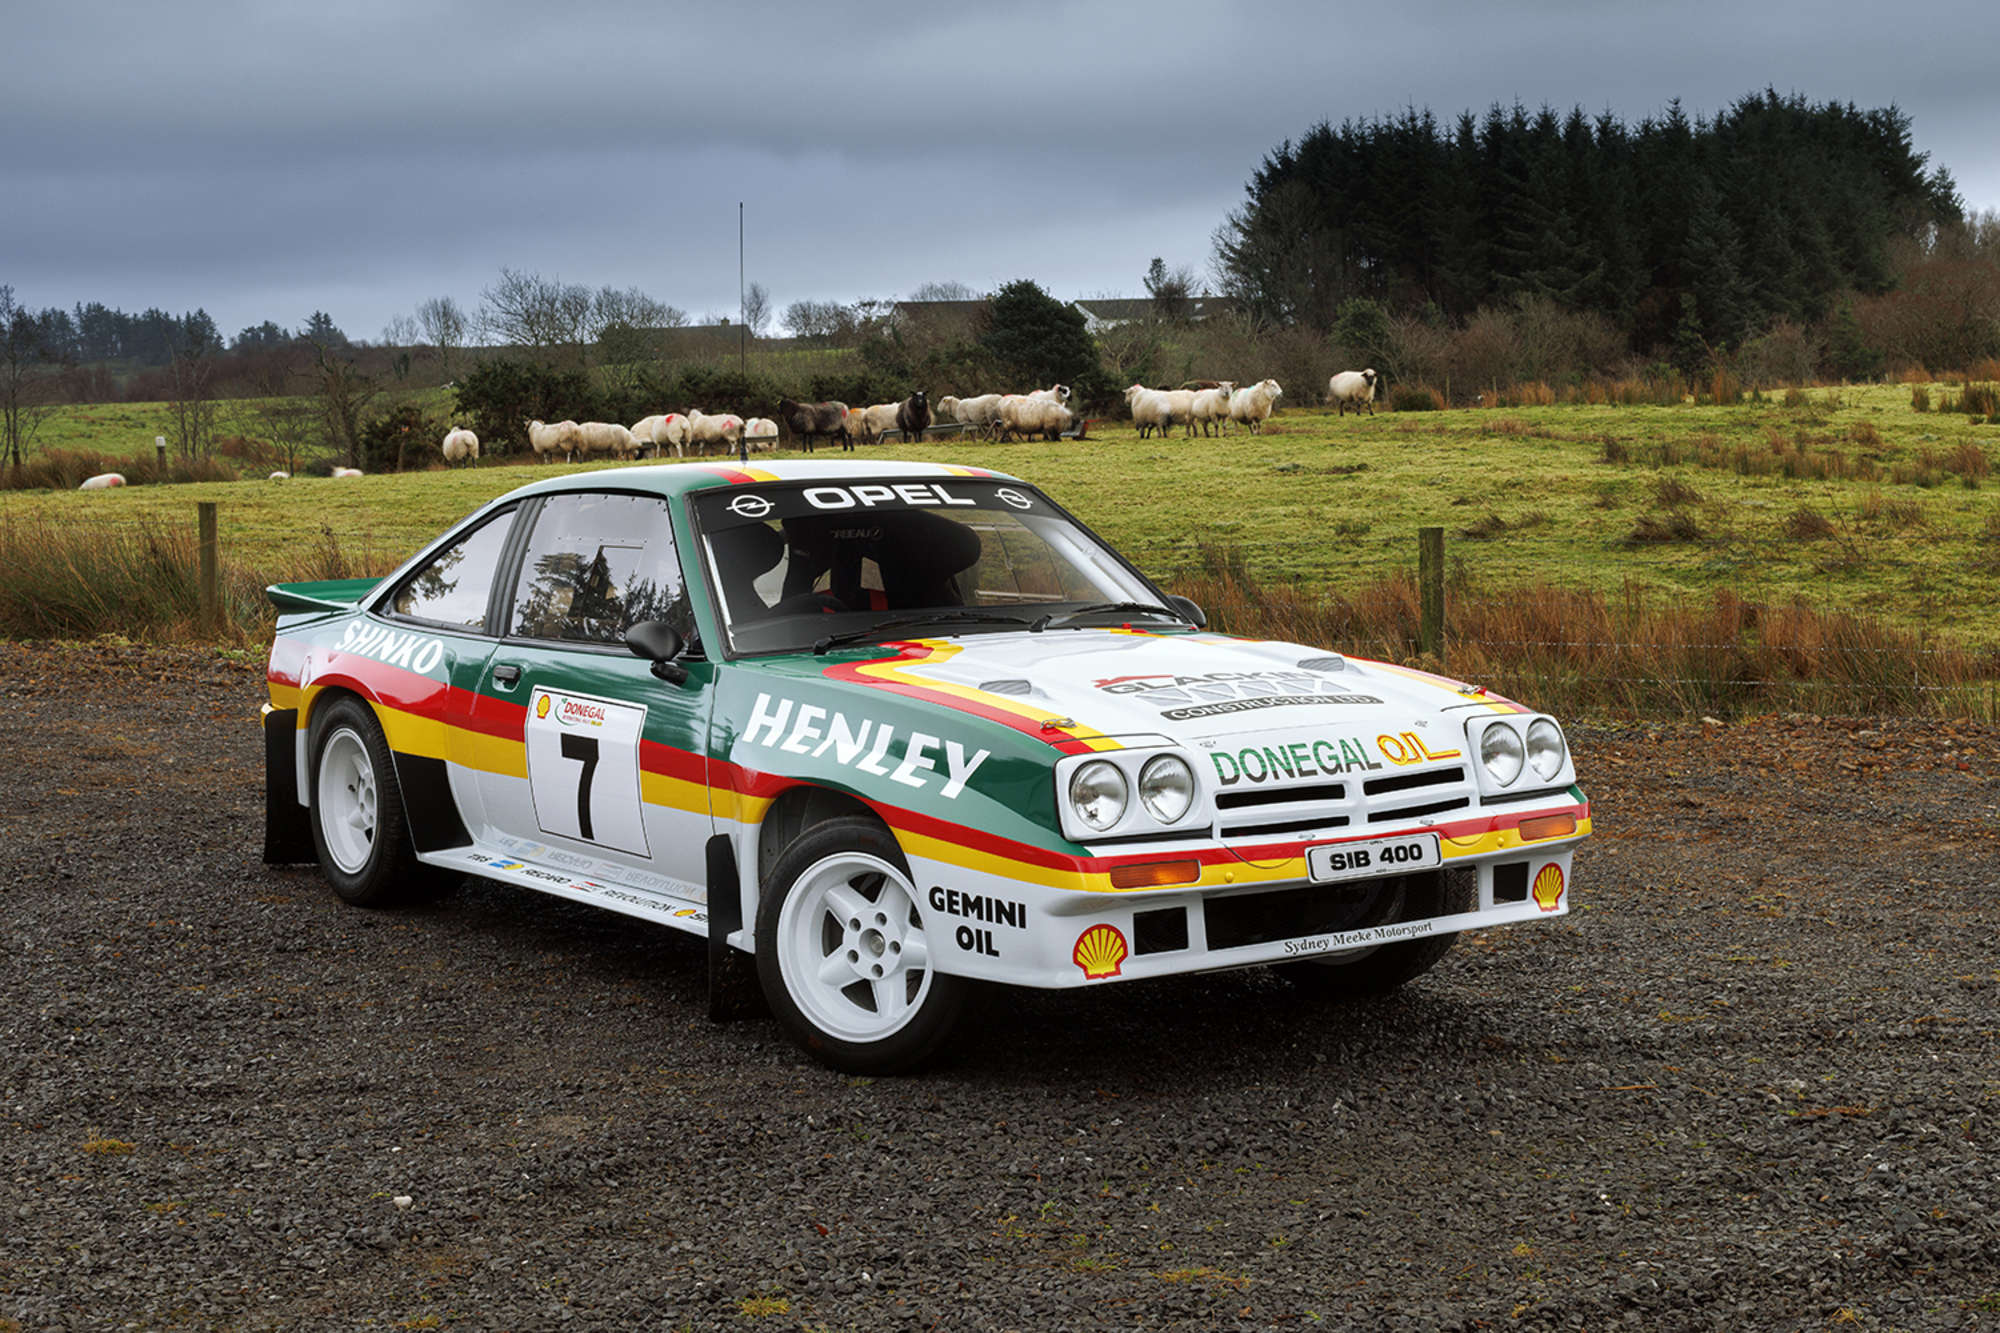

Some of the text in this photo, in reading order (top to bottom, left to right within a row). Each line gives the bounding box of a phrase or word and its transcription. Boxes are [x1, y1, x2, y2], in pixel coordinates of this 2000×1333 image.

[802, 484, 977, 510] OPEL
[334, 620, 444, 675] SHINKO
[1101, 672, 1325, 694] GLACKIN
[563, 701, 606, 721] DONEGAL
[1170, 696, 1334, 719] CONSTRUCTION
[742, 692, 992, 800] HENLEY
[1209, 731, 1461, 786] DONEGAL OIL
[560, 732, 600, 841] 7
[1329, 843, 1423, 871] SIB 400
[928, 885, 1027, 929] GEMINI
[955, 924, 1000, 957] OIL
[1284, 921, 1433, 955] Sydney Meeke Motorsport
